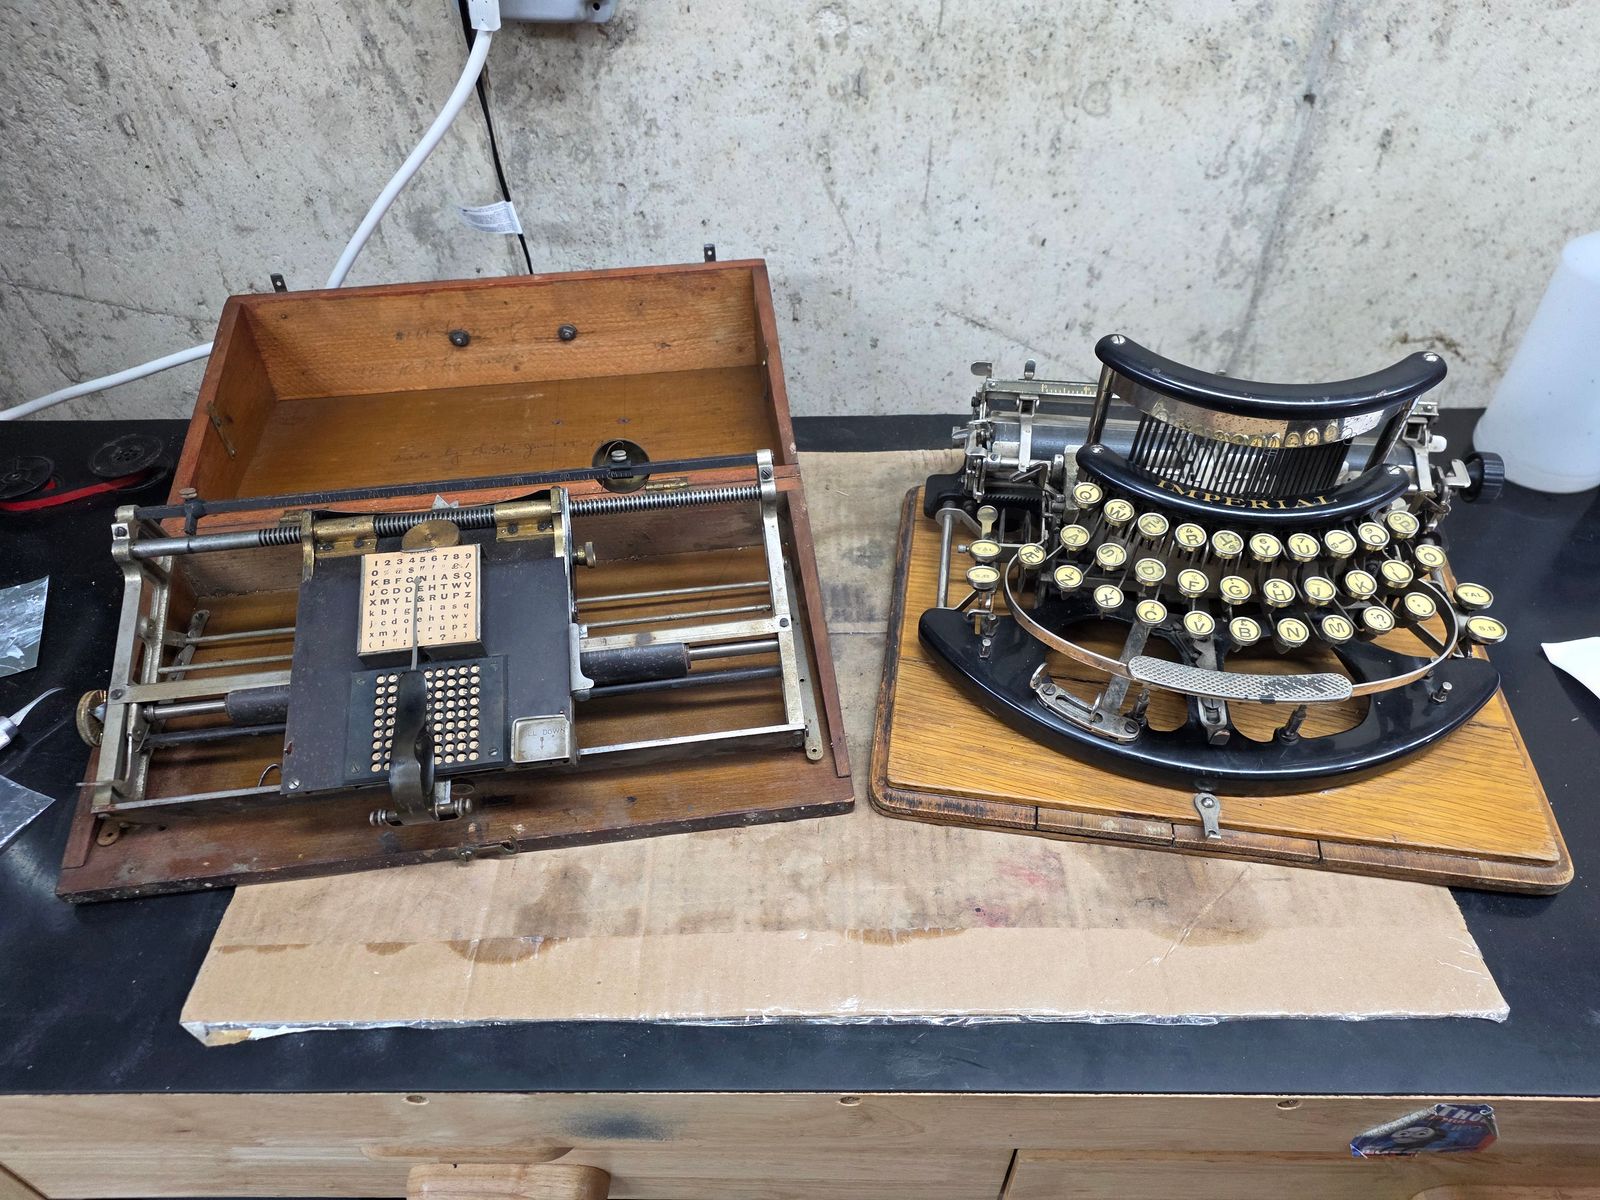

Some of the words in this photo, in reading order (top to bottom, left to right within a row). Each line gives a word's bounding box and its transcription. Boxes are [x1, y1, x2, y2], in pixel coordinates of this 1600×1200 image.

[1156, 479, 1337, 509] IMPERIAL
[1080, 491, 1091, 502] Q
[1110, 507, 1126, 518] W
[1186, 534, 1199, 544] R
[1260, 546, 1270, 555] Y
[1298, 544, 1310, 554] U
[1370, 534, 1382, 544] O
[1400, 520, 1410, 531] P
[1068, 534, 1080, 544] A
[1100, 547, 1114, 557] S
[1142, 566, 1154, 575] D
[1188, 580, 1200, 590] F
[1229, 586, 1242, 596] G
[1273, 590, 1286, 600] H
[1312, 587, 1320, 597] J
[1356, 582, 1370, 592] K
[1100, 594, 1114, 604] X
[1144, 610, 1156, 620] C
[1194, 622, 1204, 632] V
[1239, 627, 1252, 638] B
[1286, 627, 1300, 638] N
[1328, 622, 1345, 634] M
[542, 727, 566, 736] DOWN
